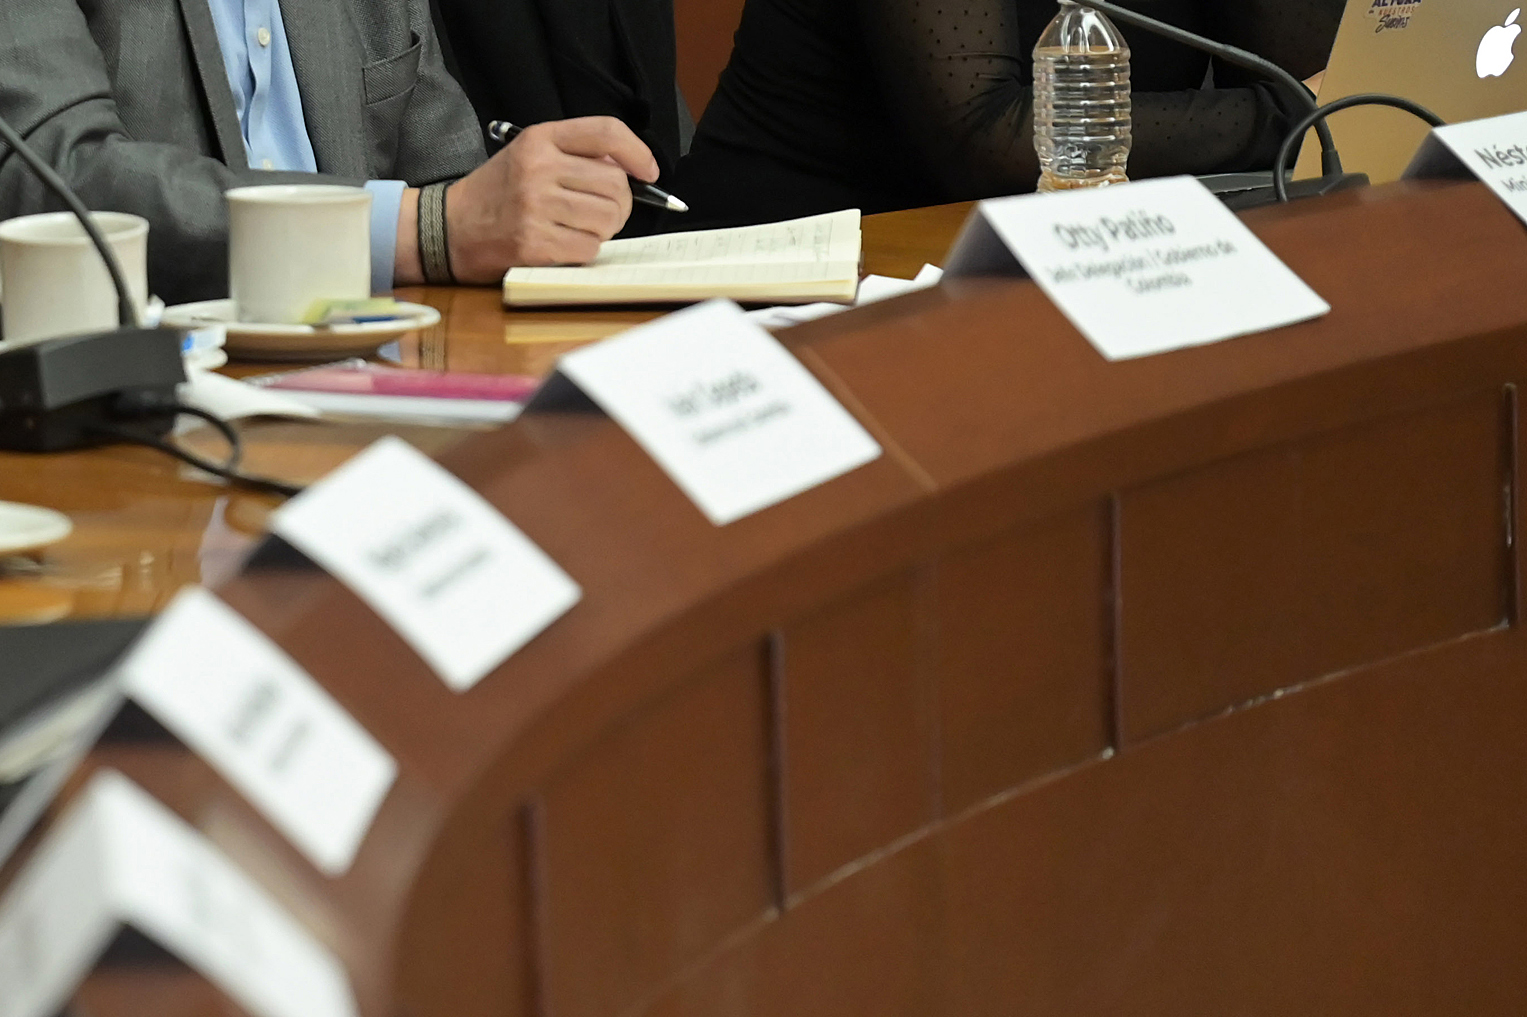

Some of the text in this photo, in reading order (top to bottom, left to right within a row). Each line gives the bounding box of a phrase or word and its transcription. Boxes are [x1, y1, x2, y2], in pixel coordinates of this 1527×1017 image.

[1474, 144, 1527, 170] Nést
[1053, 209, 1176, 253] Otty Patiño
